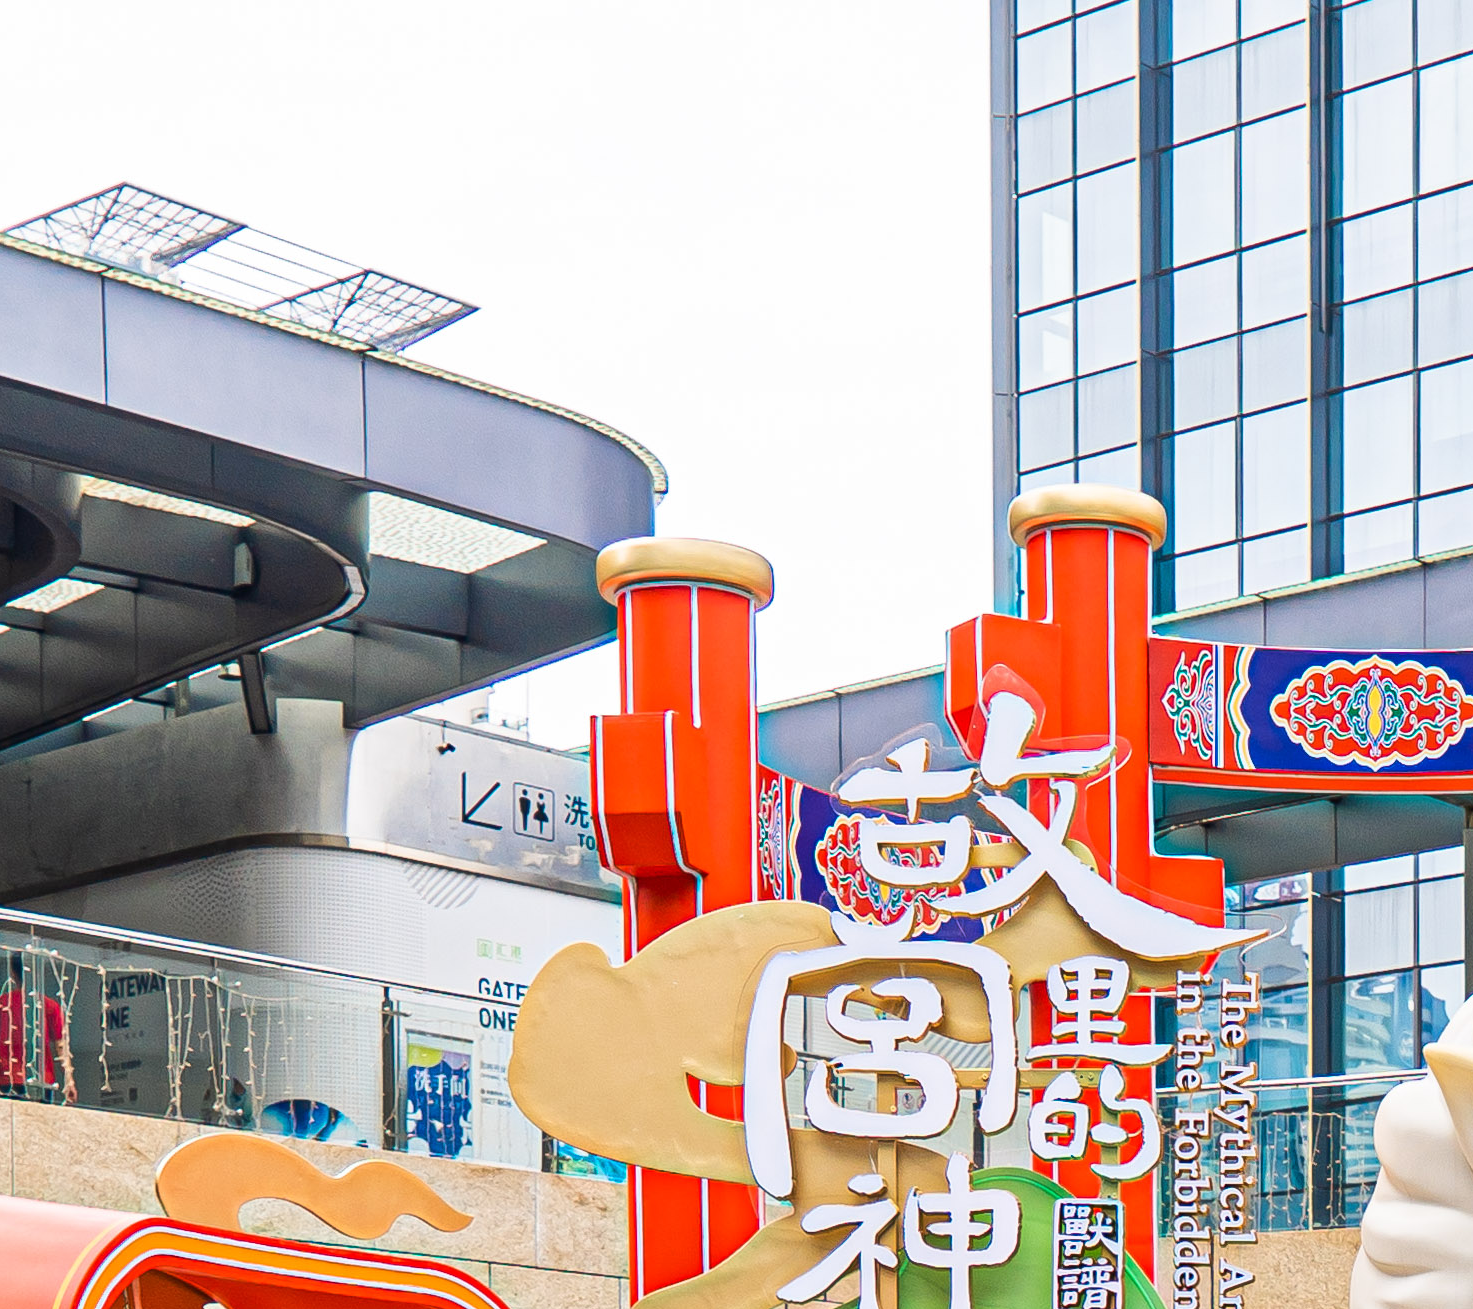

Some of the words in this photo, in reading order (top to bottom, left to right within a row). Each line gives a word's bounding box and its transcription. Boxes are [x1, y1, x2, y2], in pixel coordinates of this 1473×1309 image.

[564, 794, 594, 829] 洗
[577, 833, 599, 851] TO
[1176, 969, 1214, 1016] in
[1220, 972, 1260, 1049] The
[479, 1007, 518, 1032] ONE
[1175, 1027, 1216, 1093] the
[1213, 1061, 1259, 1245] Mythical
